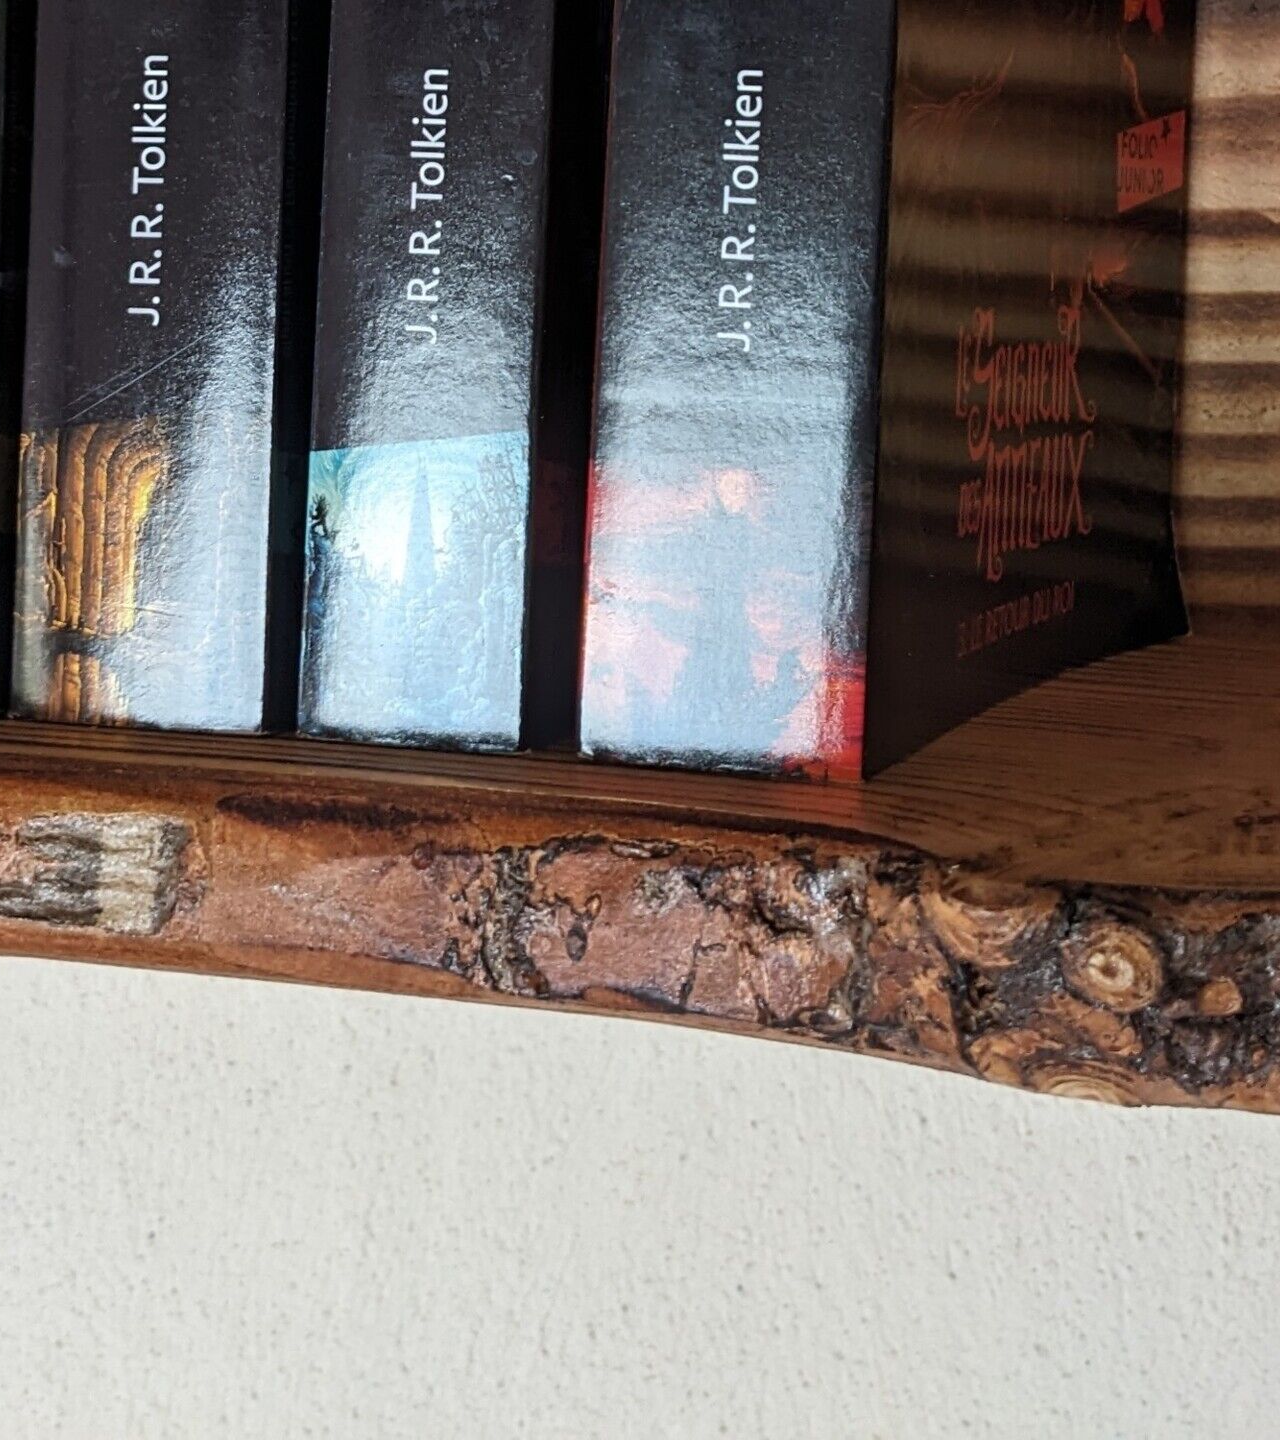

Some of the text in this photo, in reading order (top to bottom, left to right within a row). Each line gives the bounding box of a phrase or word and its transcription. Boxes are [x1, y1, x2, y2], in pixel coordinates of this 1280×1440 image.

[131, 54, 170, 195] Tolkien
[410, 68, 450, 210] Tolkien
[722, 69, 764, 215] Tolkien
[967, 305, 1097, 460] SEIGNEUR
[977, 429, 1095, 583] ANNEAUX
